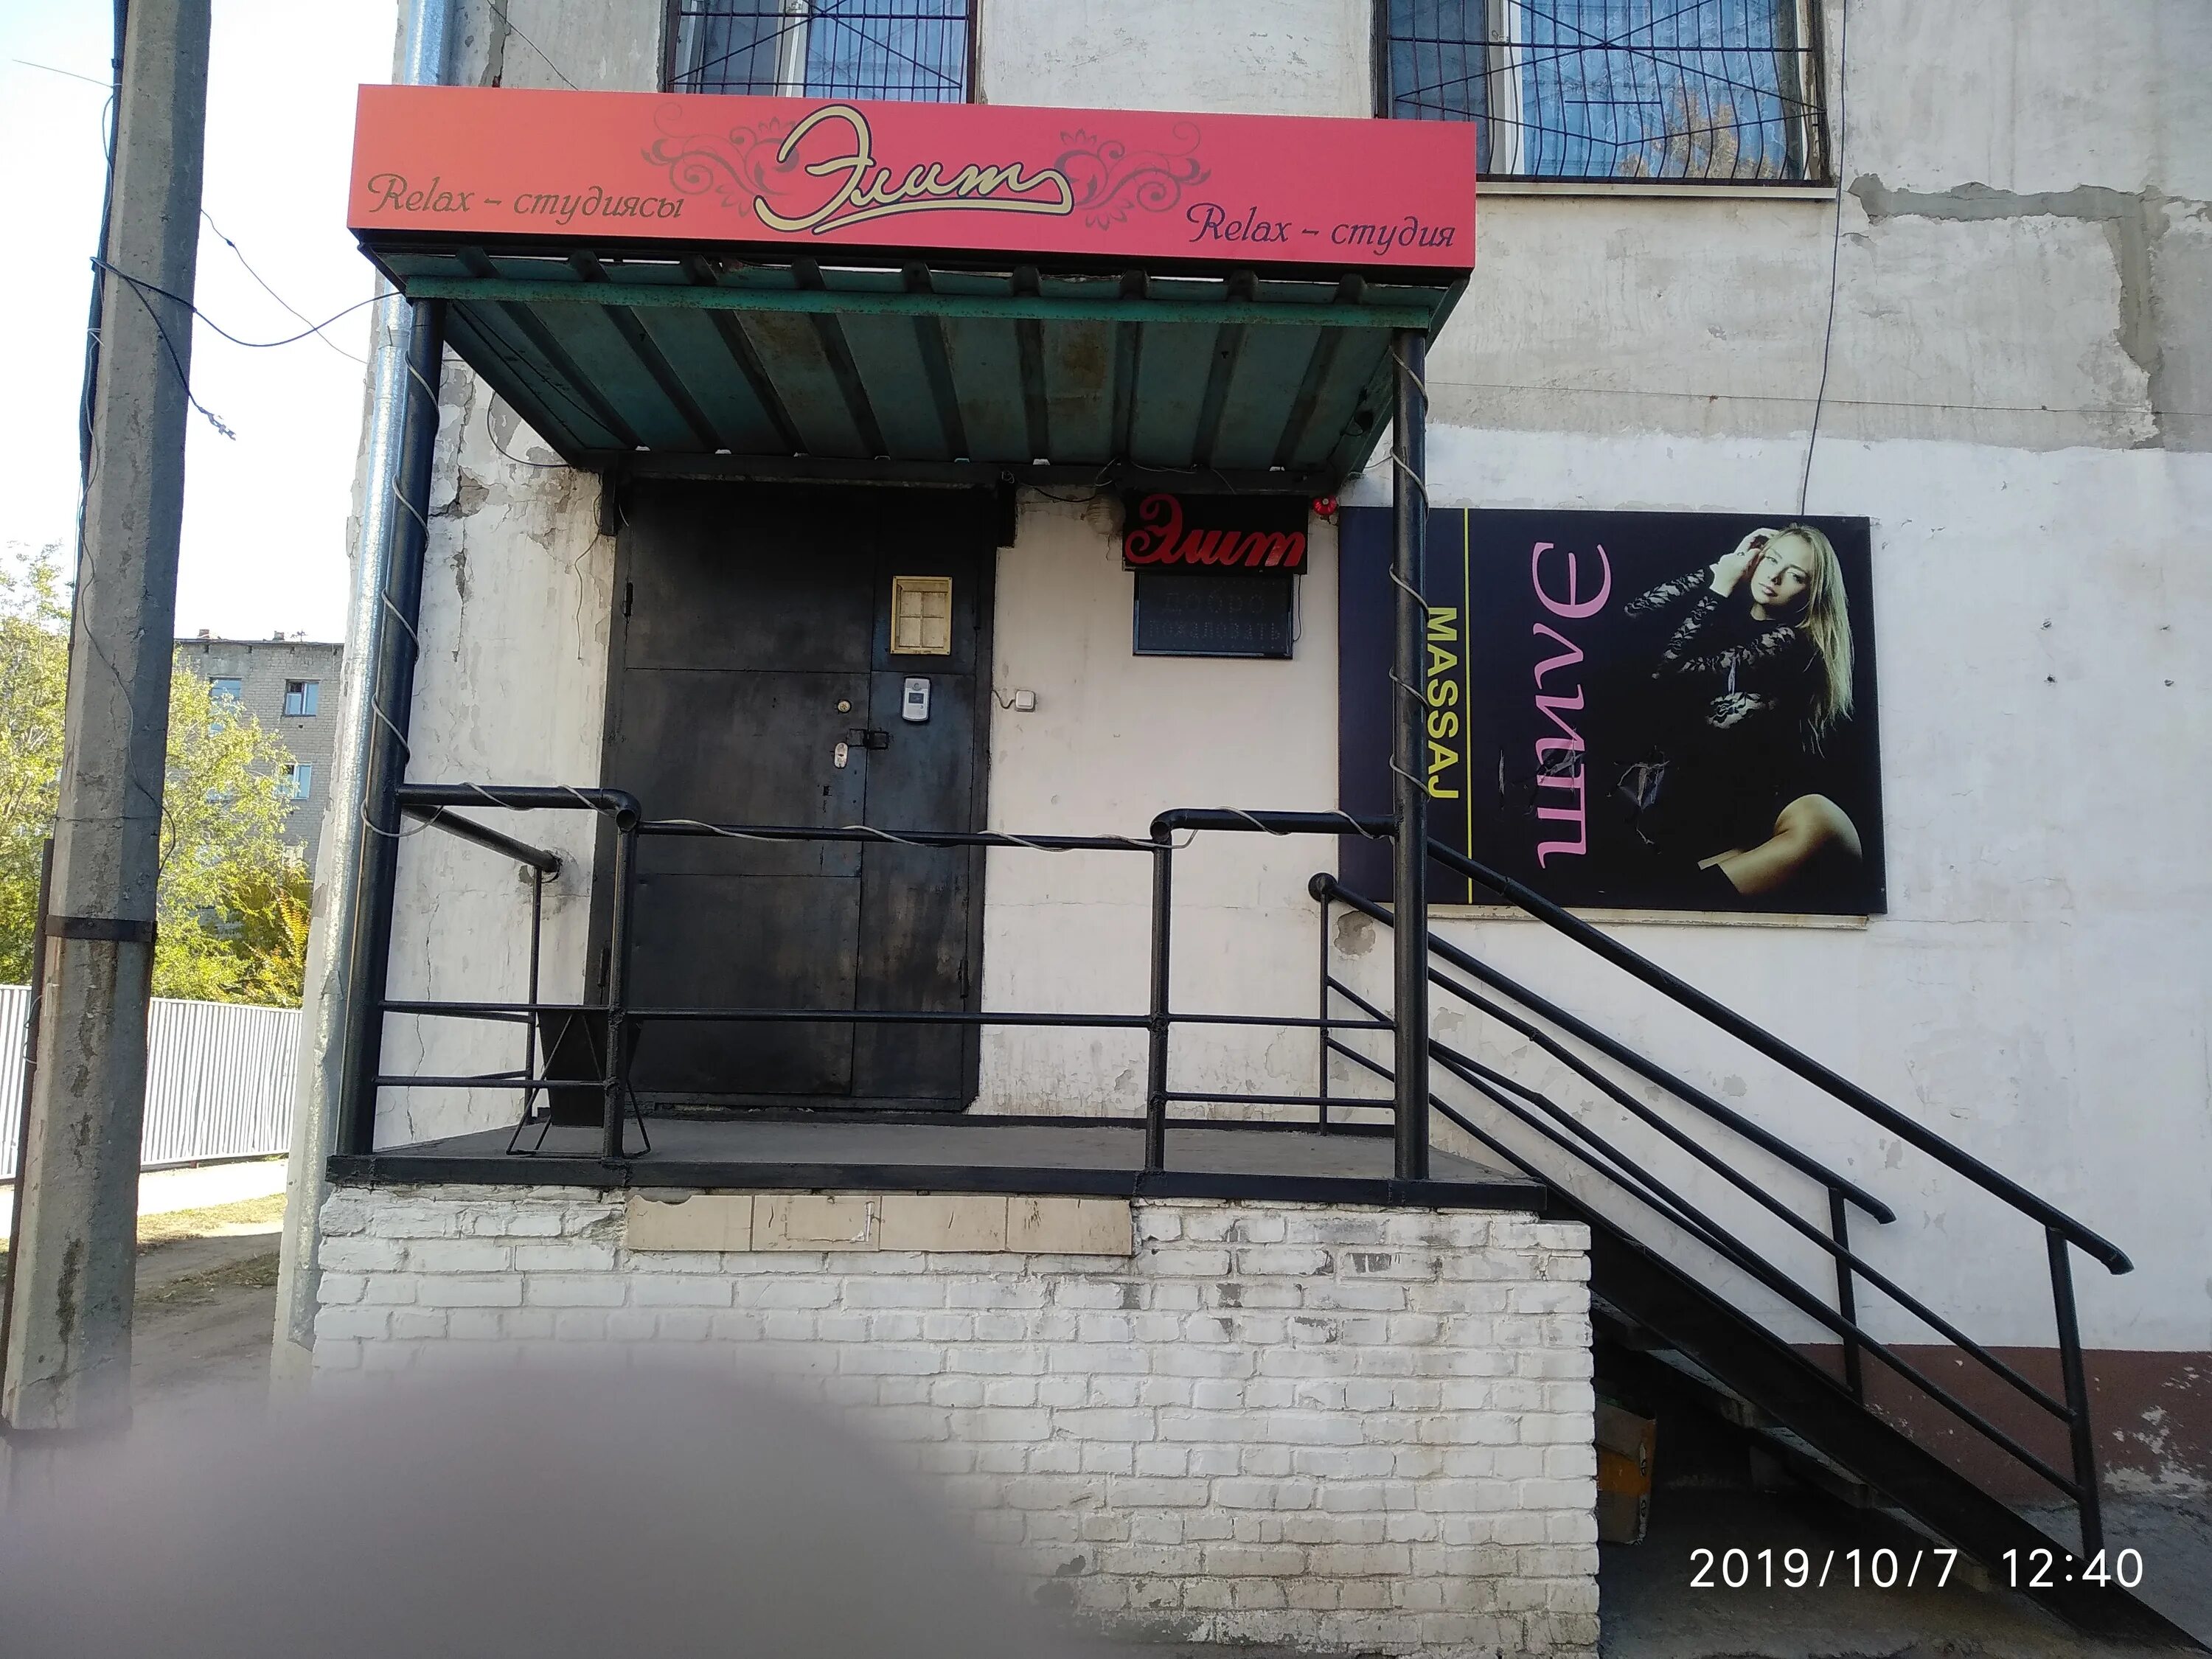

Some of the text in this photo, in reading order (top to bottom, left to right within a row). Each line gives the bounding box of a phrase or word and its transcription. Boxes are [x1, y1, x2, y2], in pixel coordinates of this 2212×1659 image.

[368, 173, 474, 214] Relax
[513, 186, 684, 226] студиясы
[754, 103, 1074, 235] Элит
[1186, 203, 1291, 243] Relax
[1331, 216, 1455, 255] студия
[1125, 493, 1306, 566] Элит
[1427, 607, 1459, 799] MASSAJ
[1532, 542, 1612, 868] Элит
